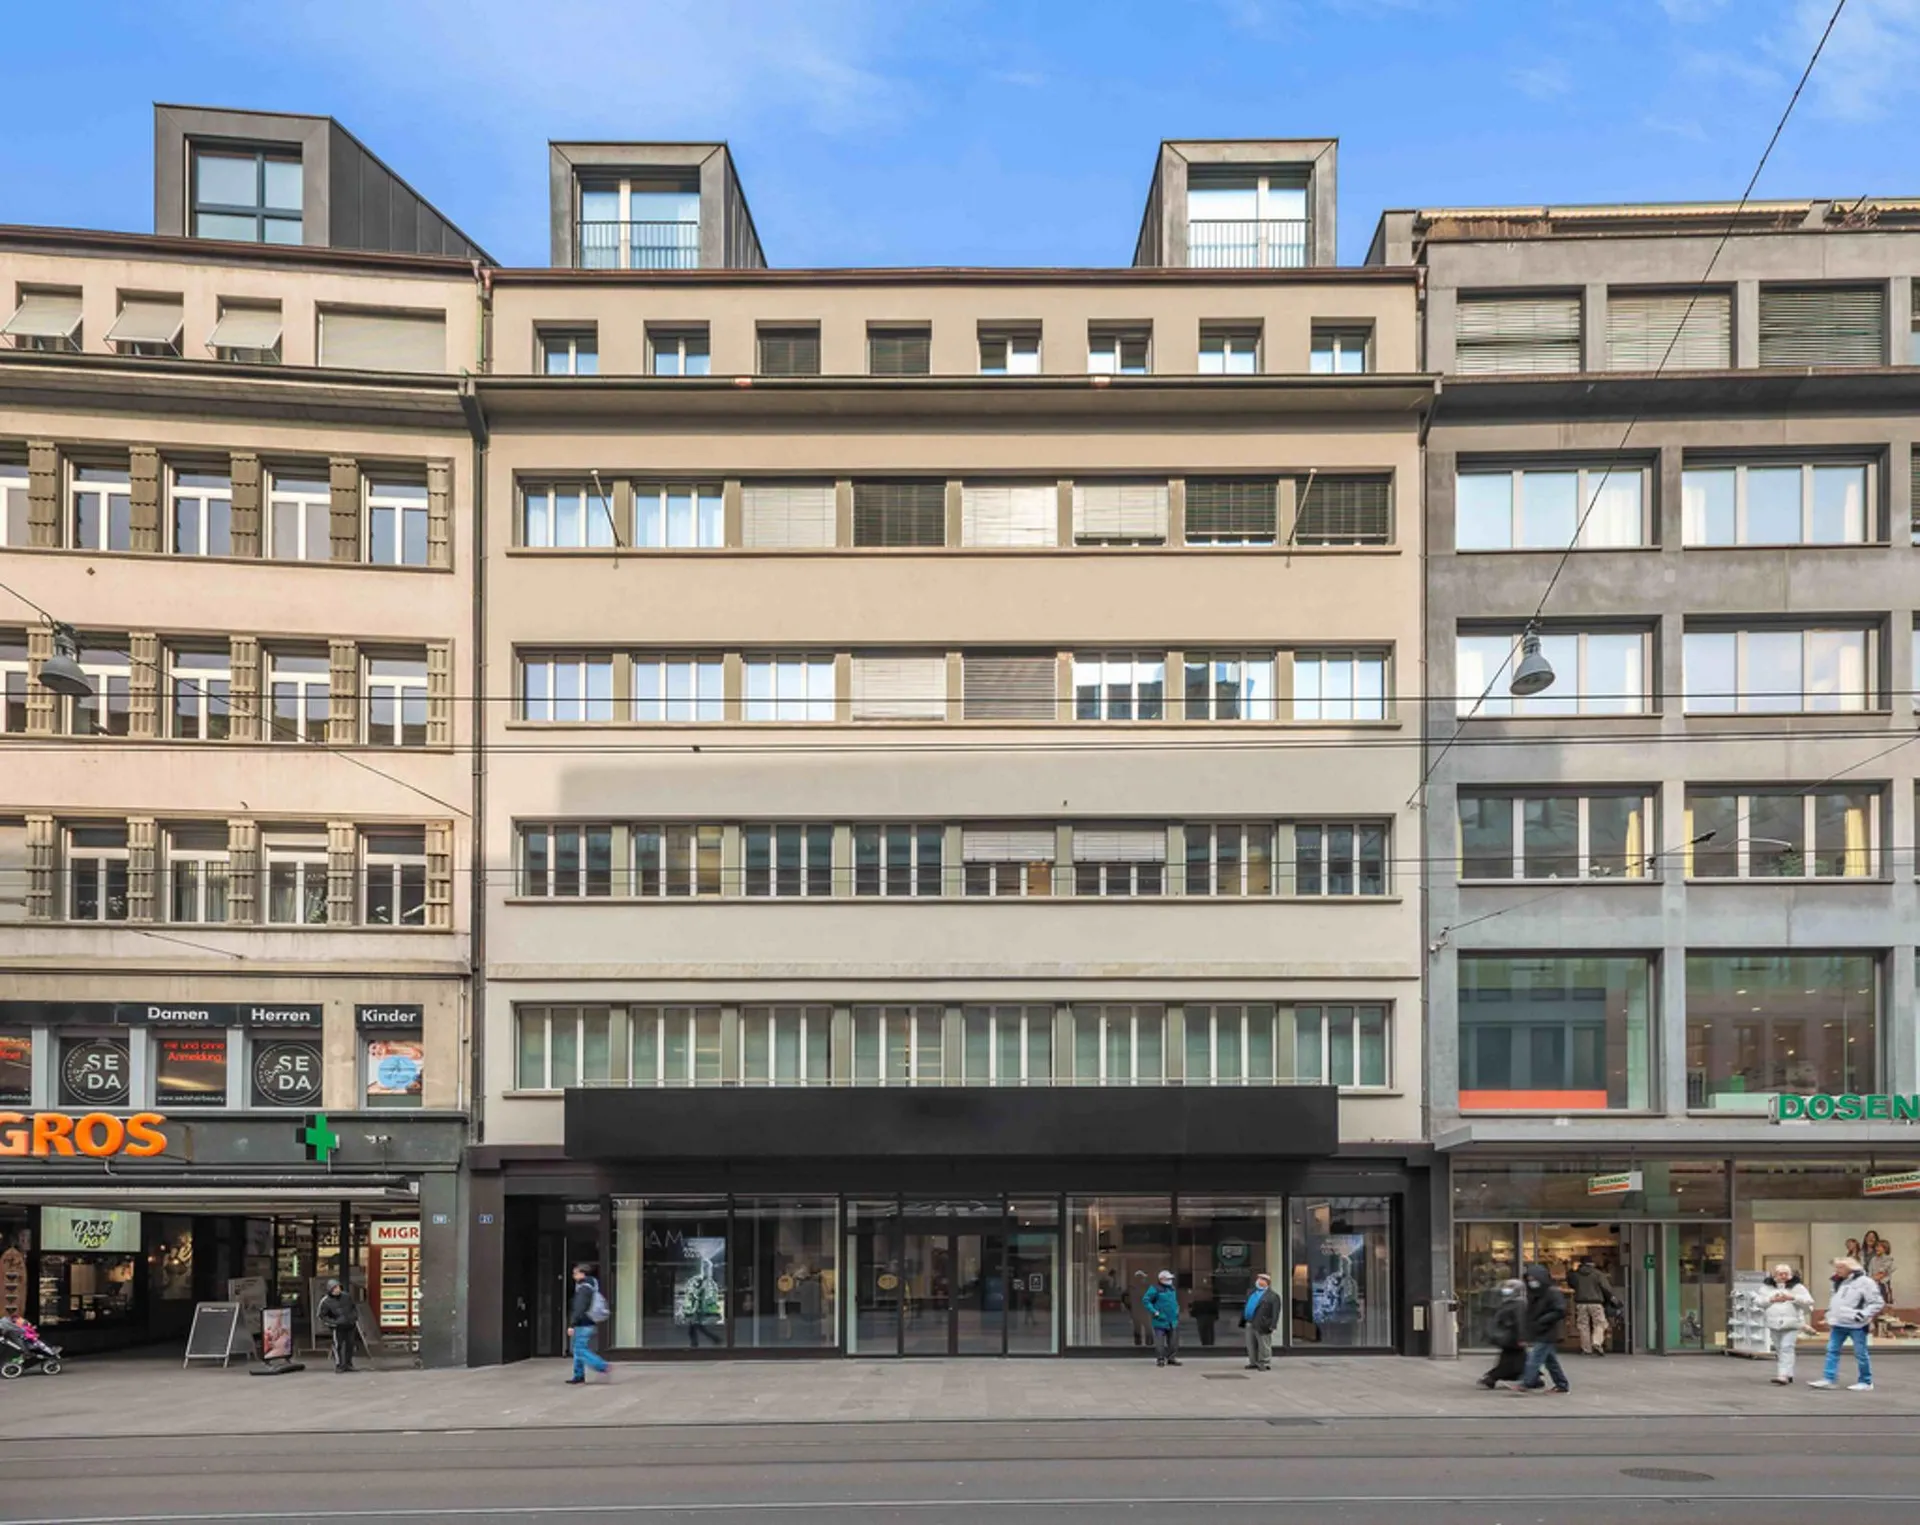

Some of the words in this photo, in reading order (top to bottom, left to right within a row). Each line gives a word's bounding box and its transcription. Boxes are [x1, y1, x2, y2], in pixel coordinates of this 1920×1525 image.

[147, 1007, 209, 1020] Damen
[251, 1008, 310, 1021] Herren
[362, 1009, 416, 1022] Kinder
[87, 1054, 119, 1071] SE
[278, 1056, 310, 1071] SE
[87, 1073, 122, 1090] DA
[278, 1074, 313, 1090] DA
[1779, 1093, 1920, 1120] DOSEN
[0, 1112, 168, 1157] GROS
[378, 1226, 419, 1239] MIGR
